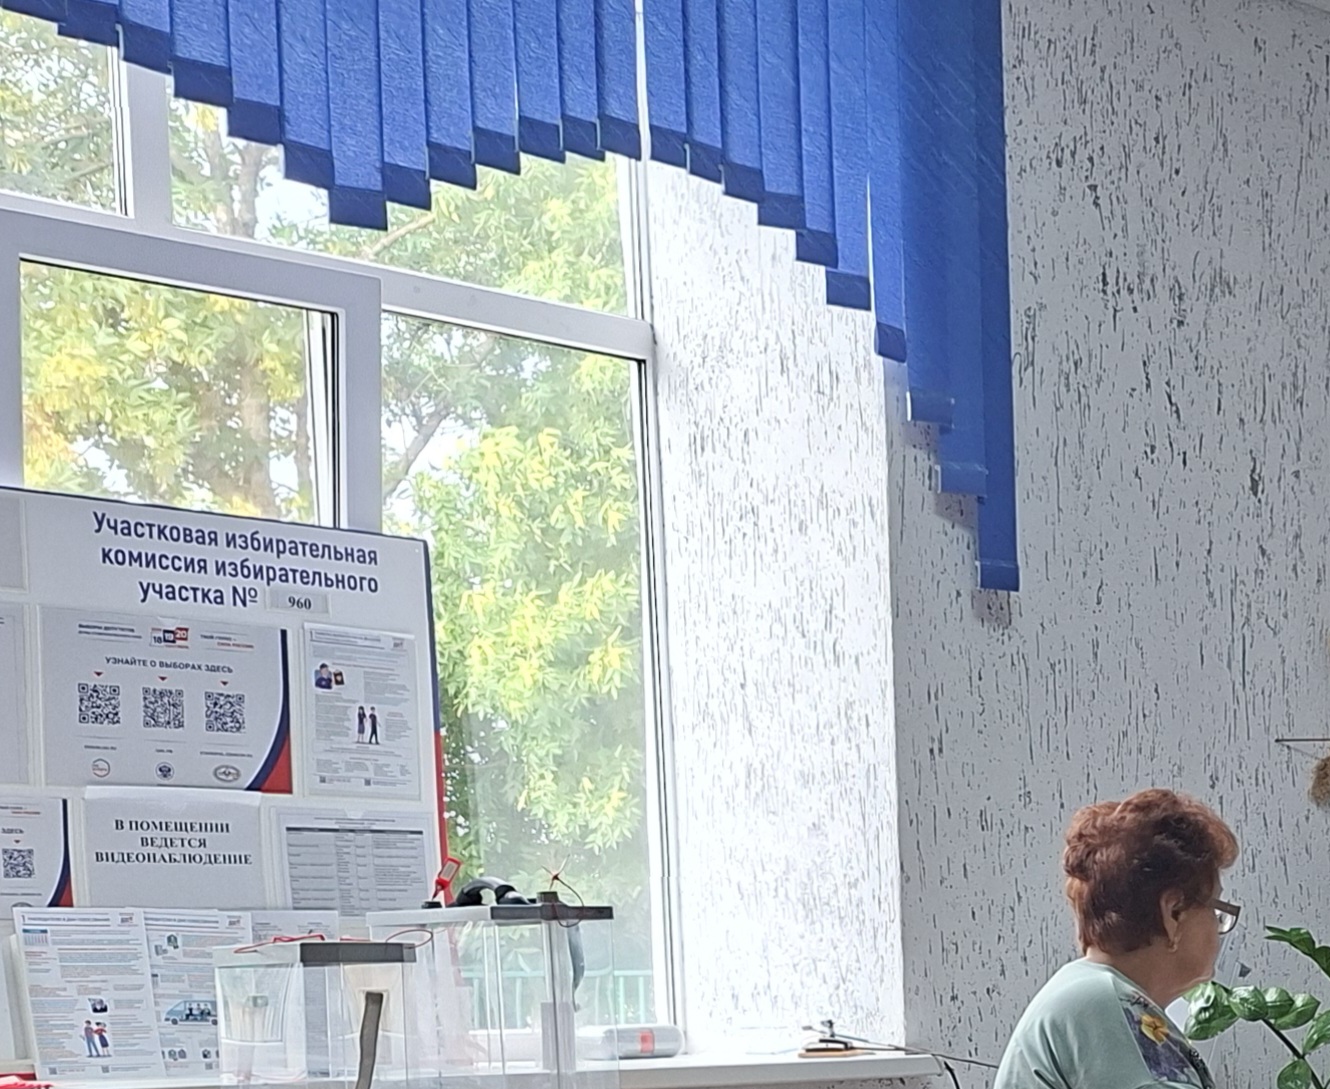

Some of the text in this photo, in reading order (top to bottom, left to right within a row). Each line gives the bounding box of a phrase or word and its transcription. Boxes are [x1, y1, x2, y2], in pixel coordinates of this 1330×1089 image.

[93, 511, 379, 566] Участковая избирательная
[101, 547, 379, 593] комиссия избирательного
[139, 581, 312, 610] участка № 960
[105, 656, 233, 674] УЗНАЙТЕ О ВЫБОРАХ ЗДЕСЬ
[115, 819, 231, 834] В ПОМЕЩЕНИИ
[140, 836, 207, 849] ВЕДЕТСЯ
[95, 851, 253, 866] ВИДЕОНАБЛЮДЕНИЕ
